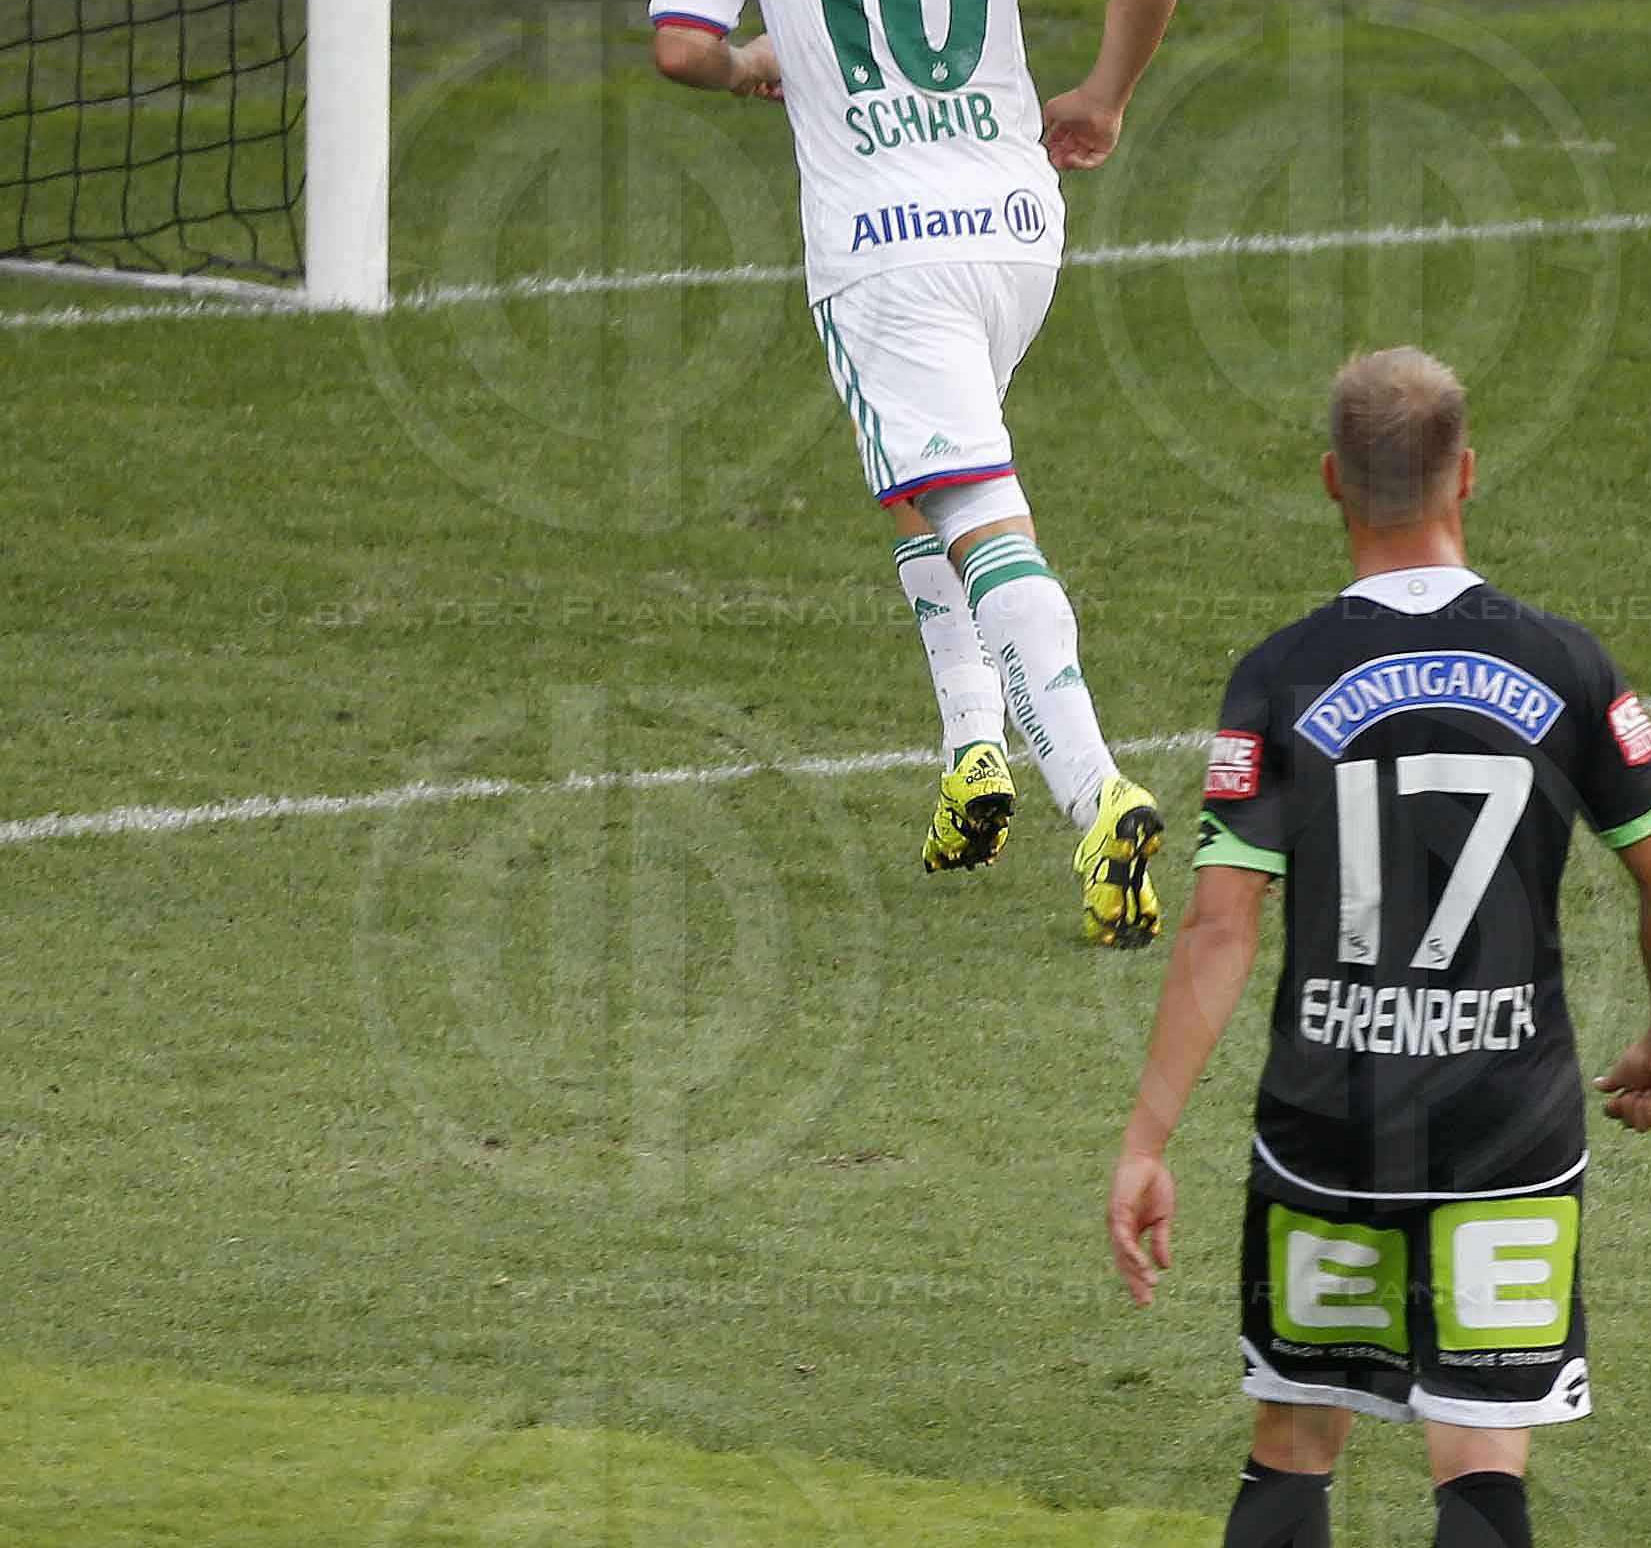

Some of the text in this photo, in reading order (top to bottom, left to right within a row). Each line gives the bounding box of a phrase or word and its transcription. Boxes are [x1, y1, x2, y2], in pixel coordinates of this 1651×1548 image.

[851, 203, 997, 252] Allianz
[1313, 660, 1549, 743] PUNTIGAMER
[1336, 752, 1535, 970] 17
